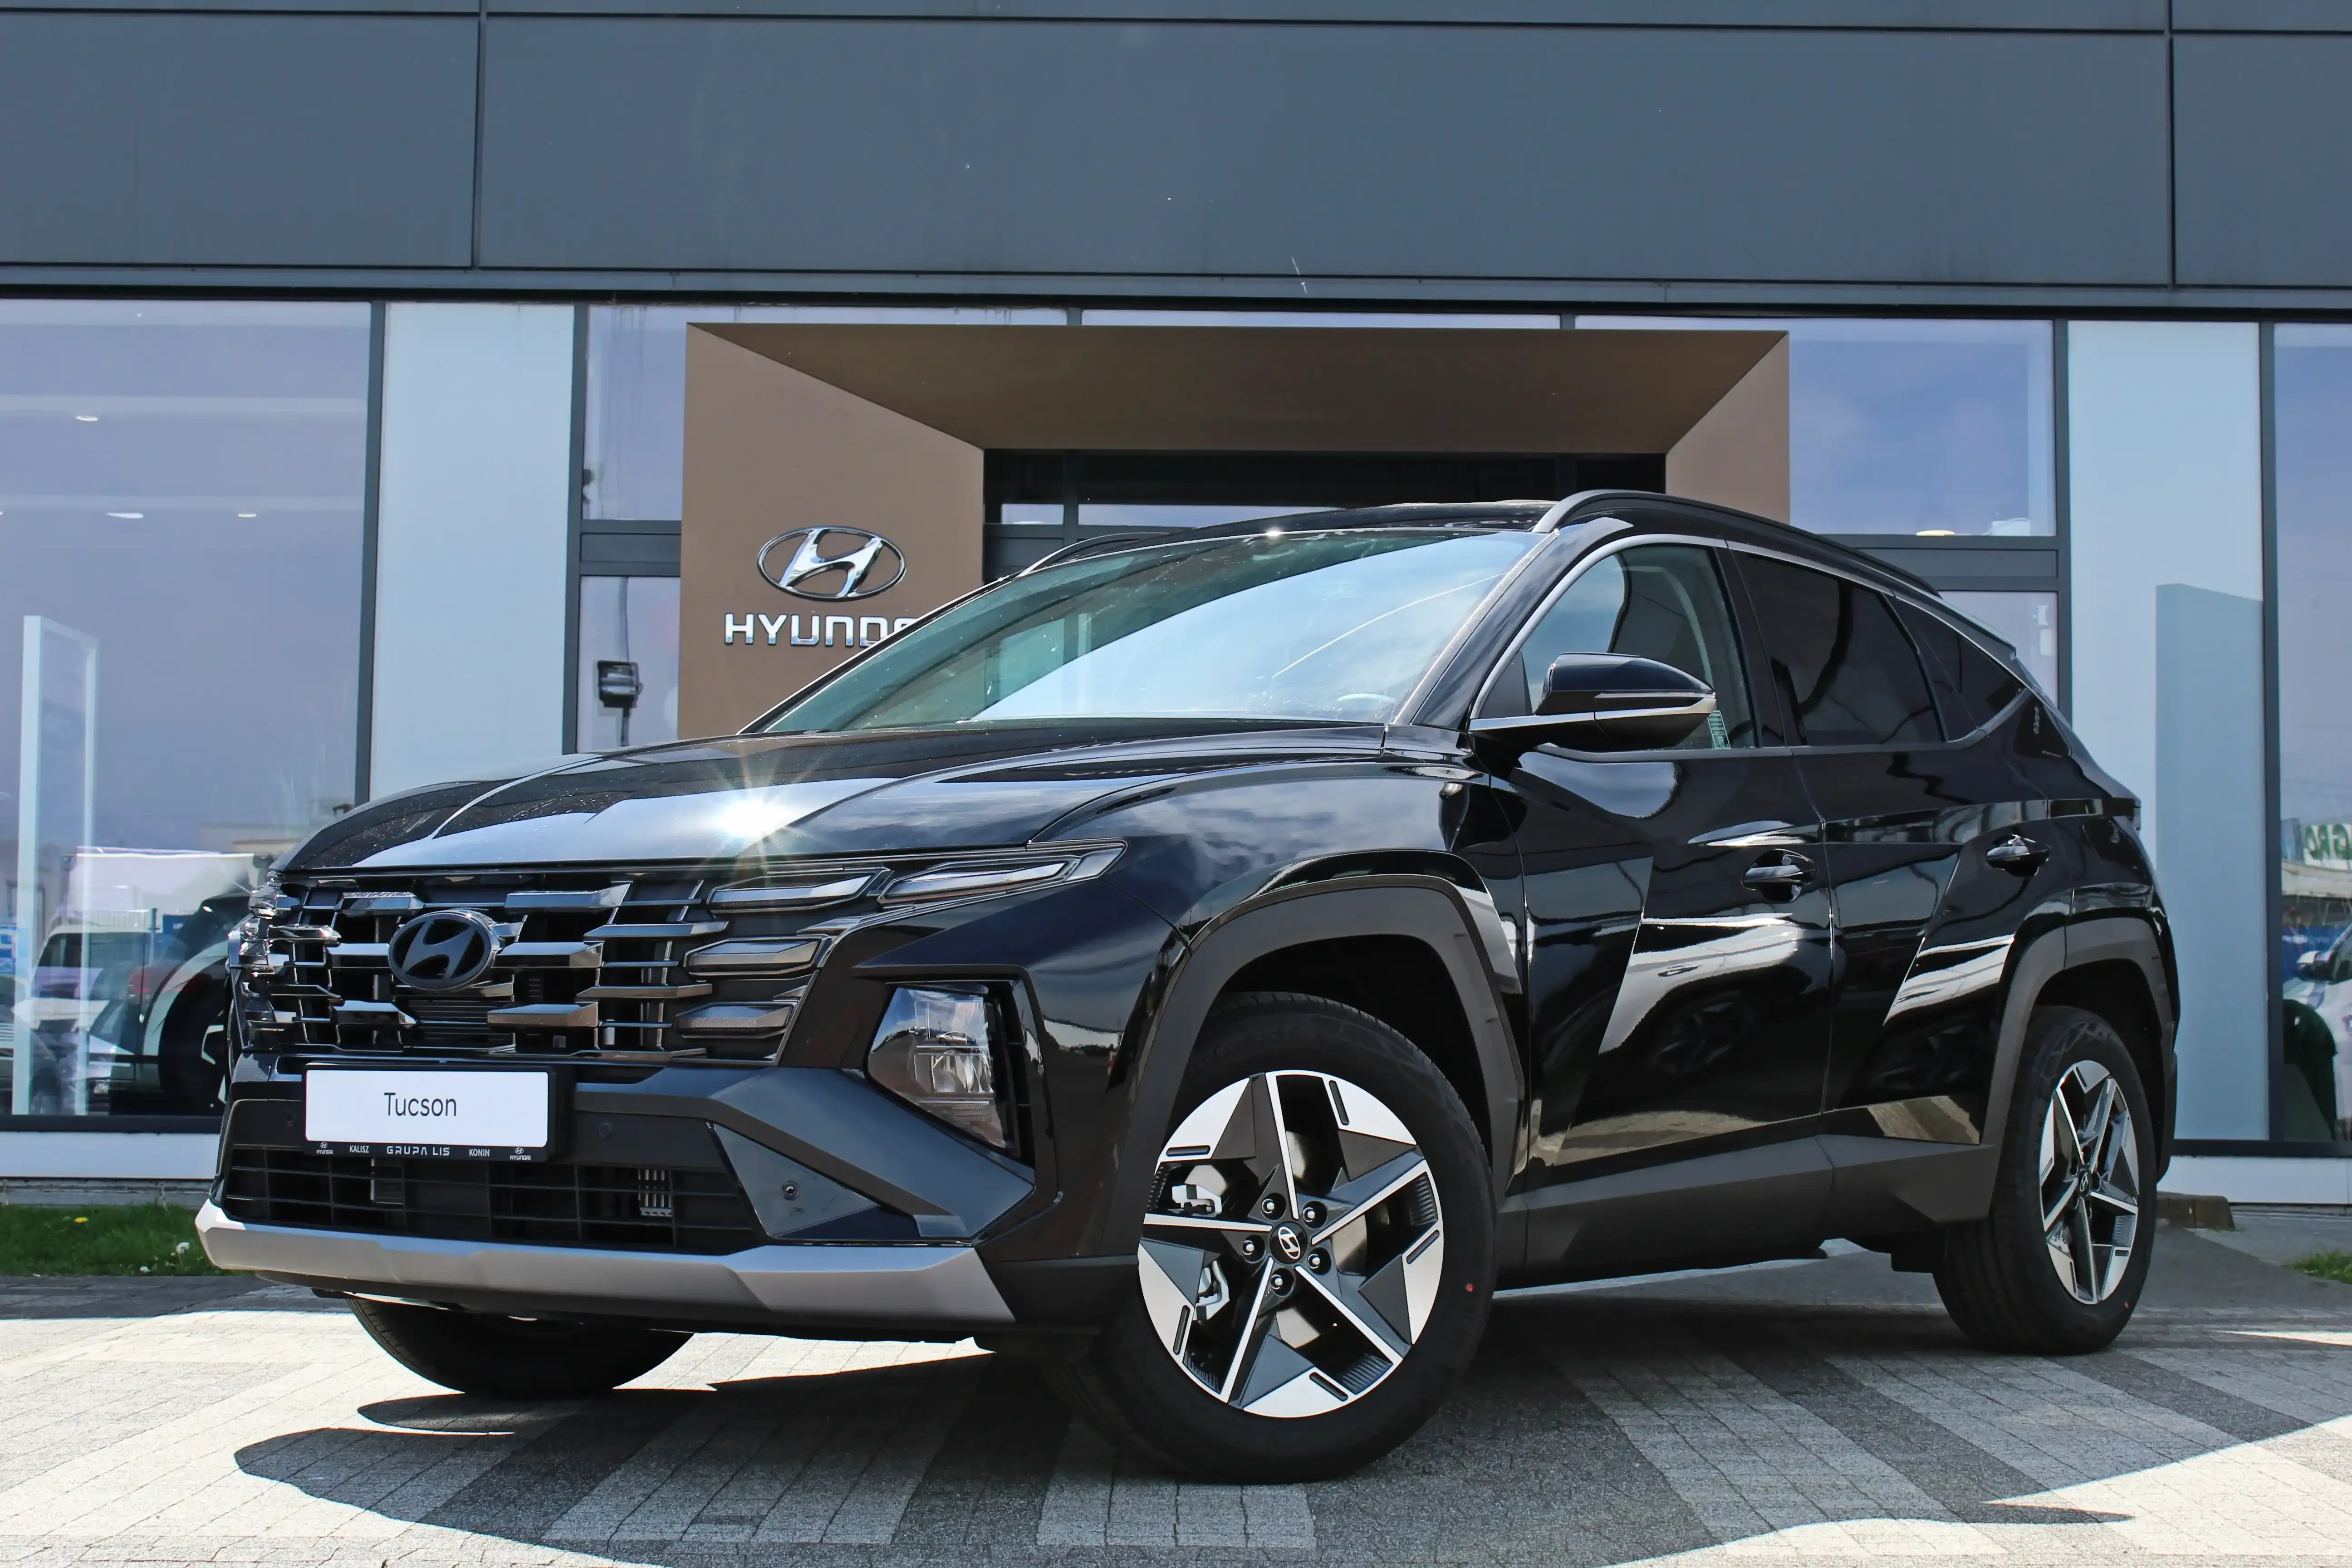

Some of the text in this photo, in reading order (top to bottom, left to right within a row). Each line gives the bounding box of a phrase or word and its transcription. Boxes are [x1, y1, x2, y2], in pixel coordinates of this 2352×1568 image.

[725, 613, 919, 647] HYUND
[384, 1092, 457, 1117] Tucson
[349, 1145, 369, 1153] KALISZ
[387, 1146, 428, 1156] GRUPA
[432, 1147, 450, 1156] LIS
[469, 1148, 490, 1157] KONIN
